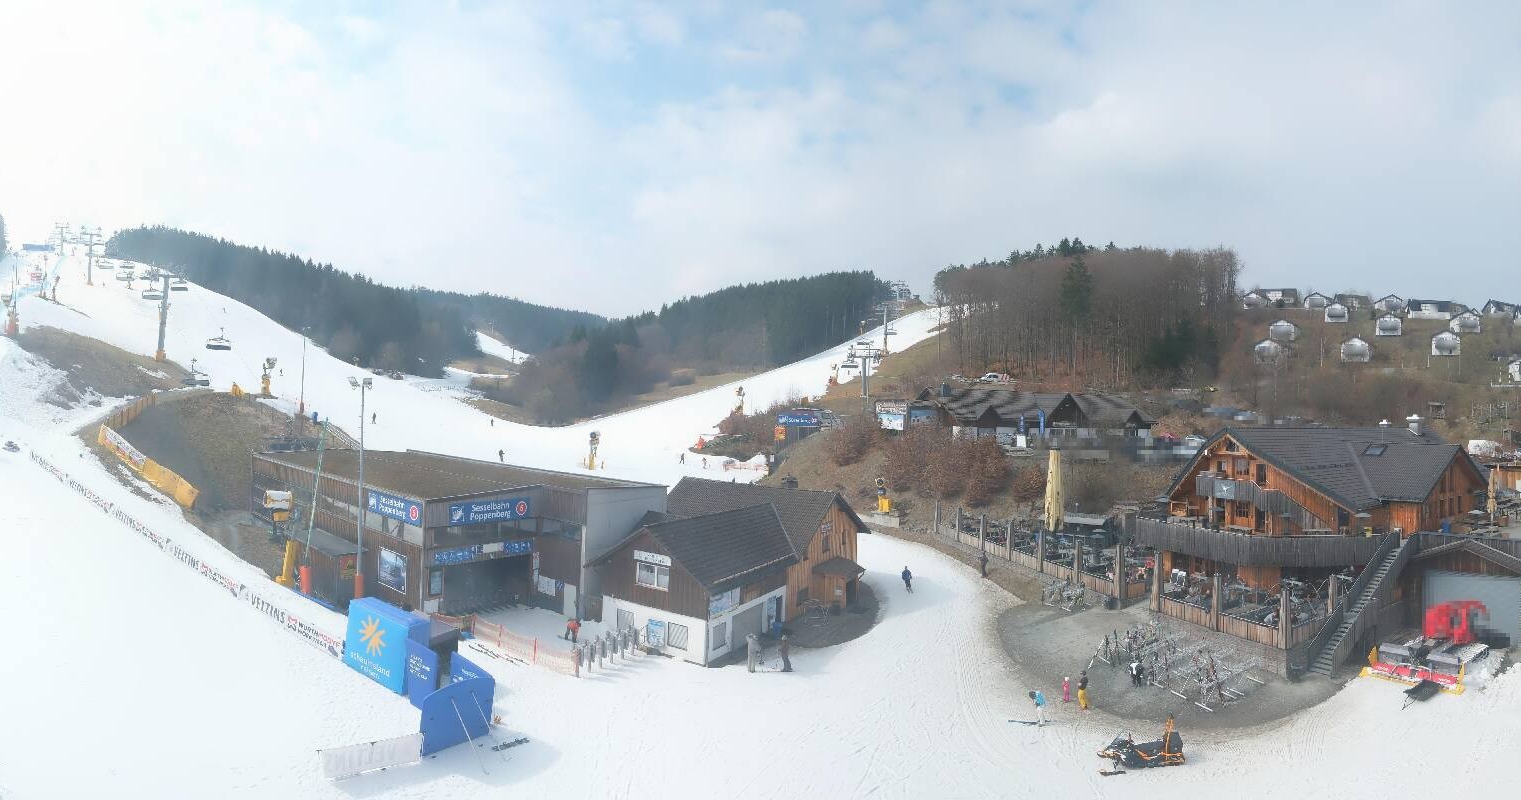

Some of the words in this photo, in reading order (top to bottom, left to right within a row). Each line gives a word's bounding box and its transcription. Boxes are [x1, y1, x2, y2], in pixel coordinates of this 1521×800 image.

[380, 495, 406, 509] Sesselbahn
[471, 501, 510, 512] Sesselbahn
[378, 503, 406, 520] Poppenberg
[470, 510, 511, 522] Poppenberg
[173, 545, 200, 571] VELTINS
[251, 593, 286, 624] VELTINS
